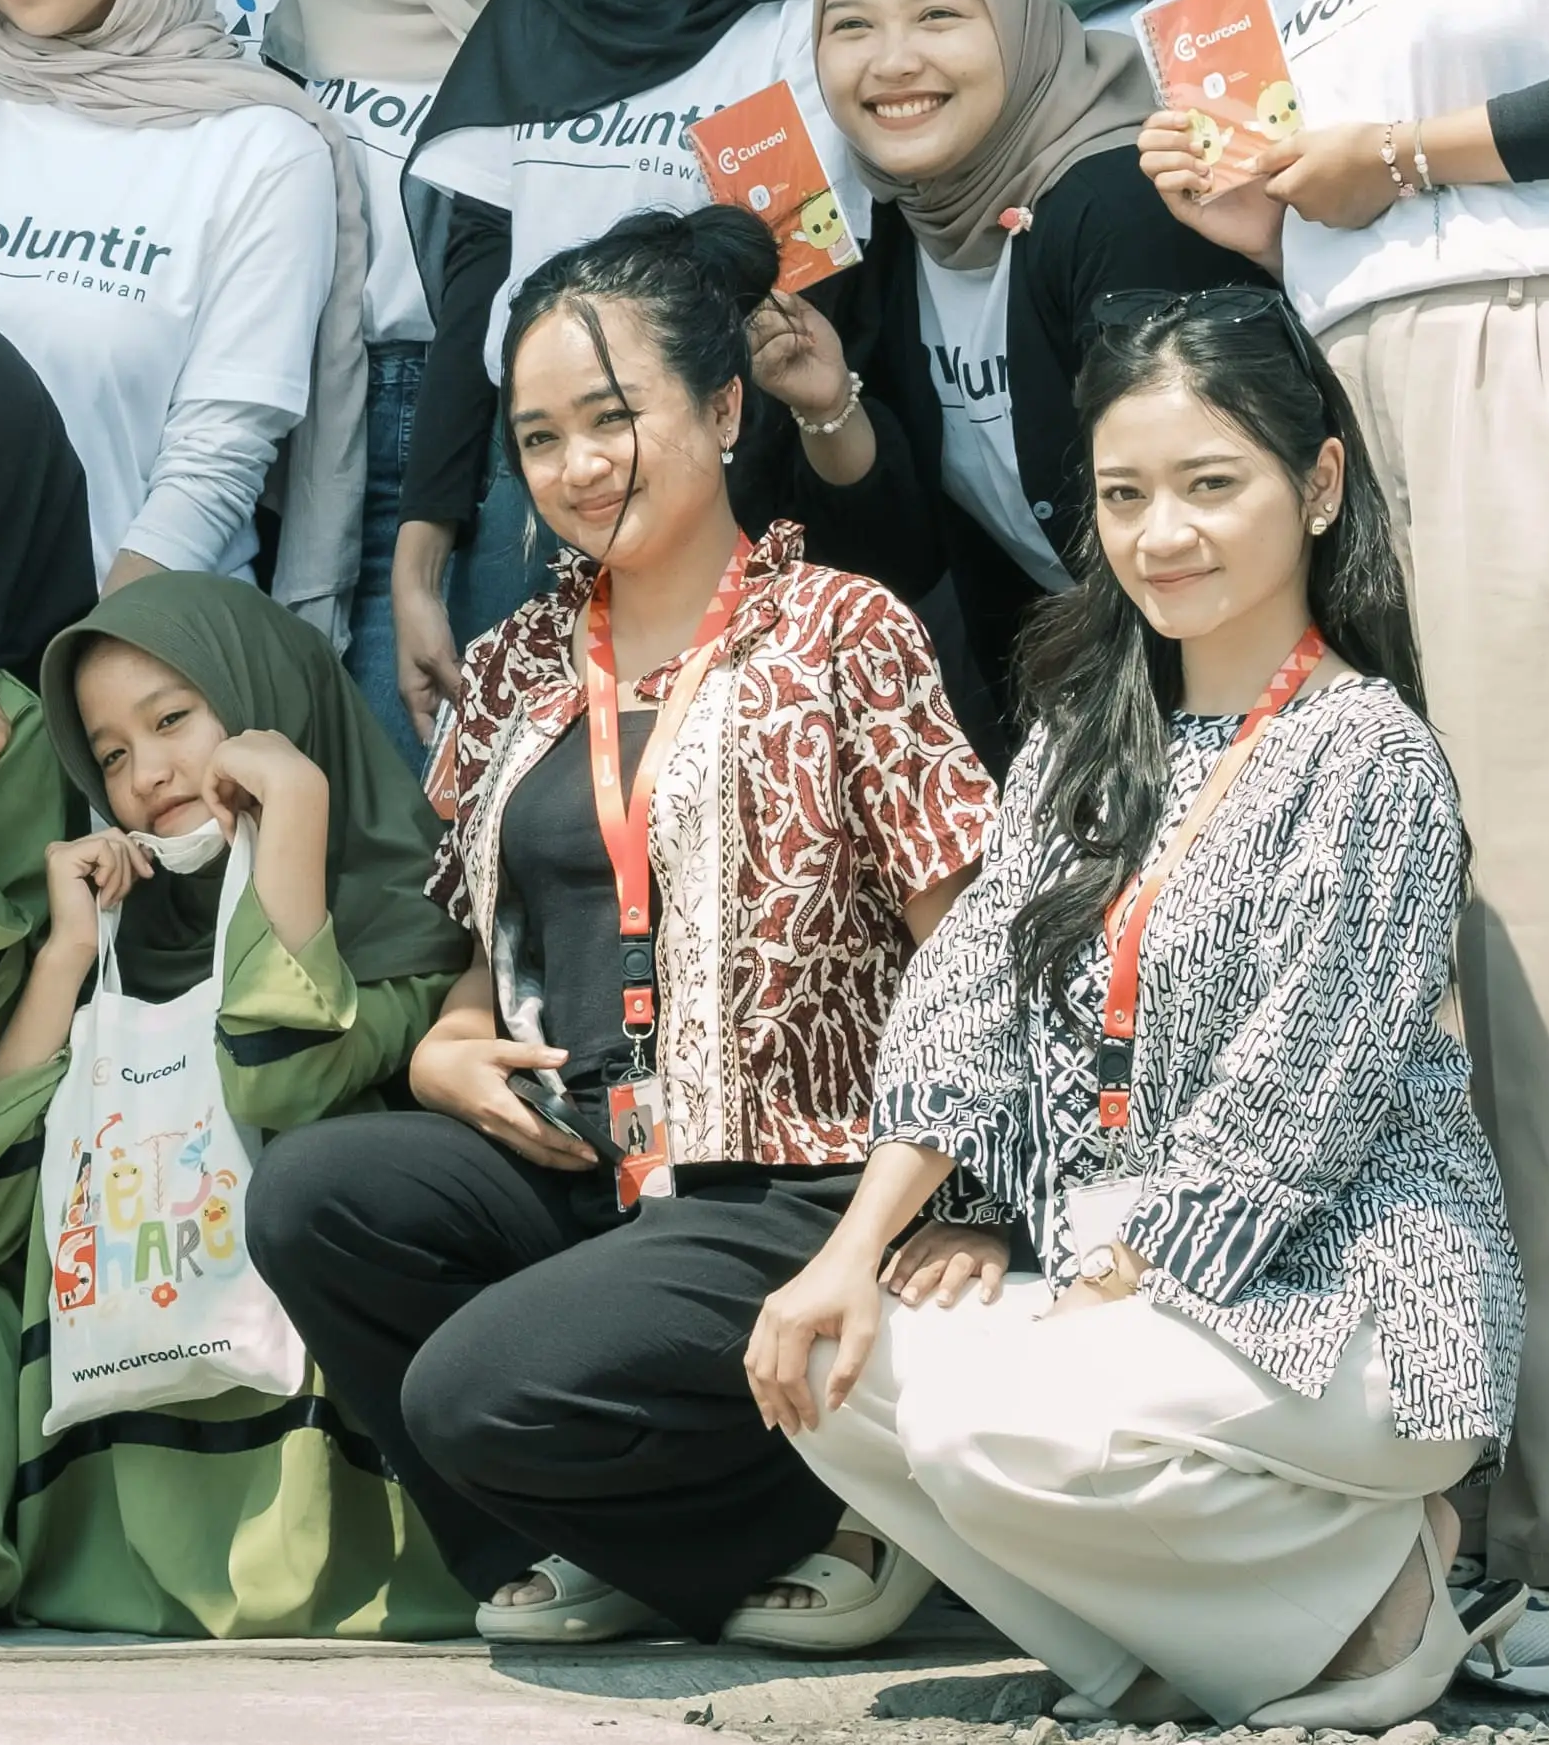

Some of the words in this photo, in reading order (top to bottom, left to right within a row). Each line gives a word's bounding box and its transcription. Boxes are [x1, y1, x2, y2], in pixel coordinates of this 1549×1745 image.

[1195, 14, 1252, 49] Curcool
[737, 127, 788, 162] Curcool
[46, 270, 147, 303] relawan
[121, 1055, 186, 1085] Curcool
[72, 1337, 232, 1383] www.curcool.com
